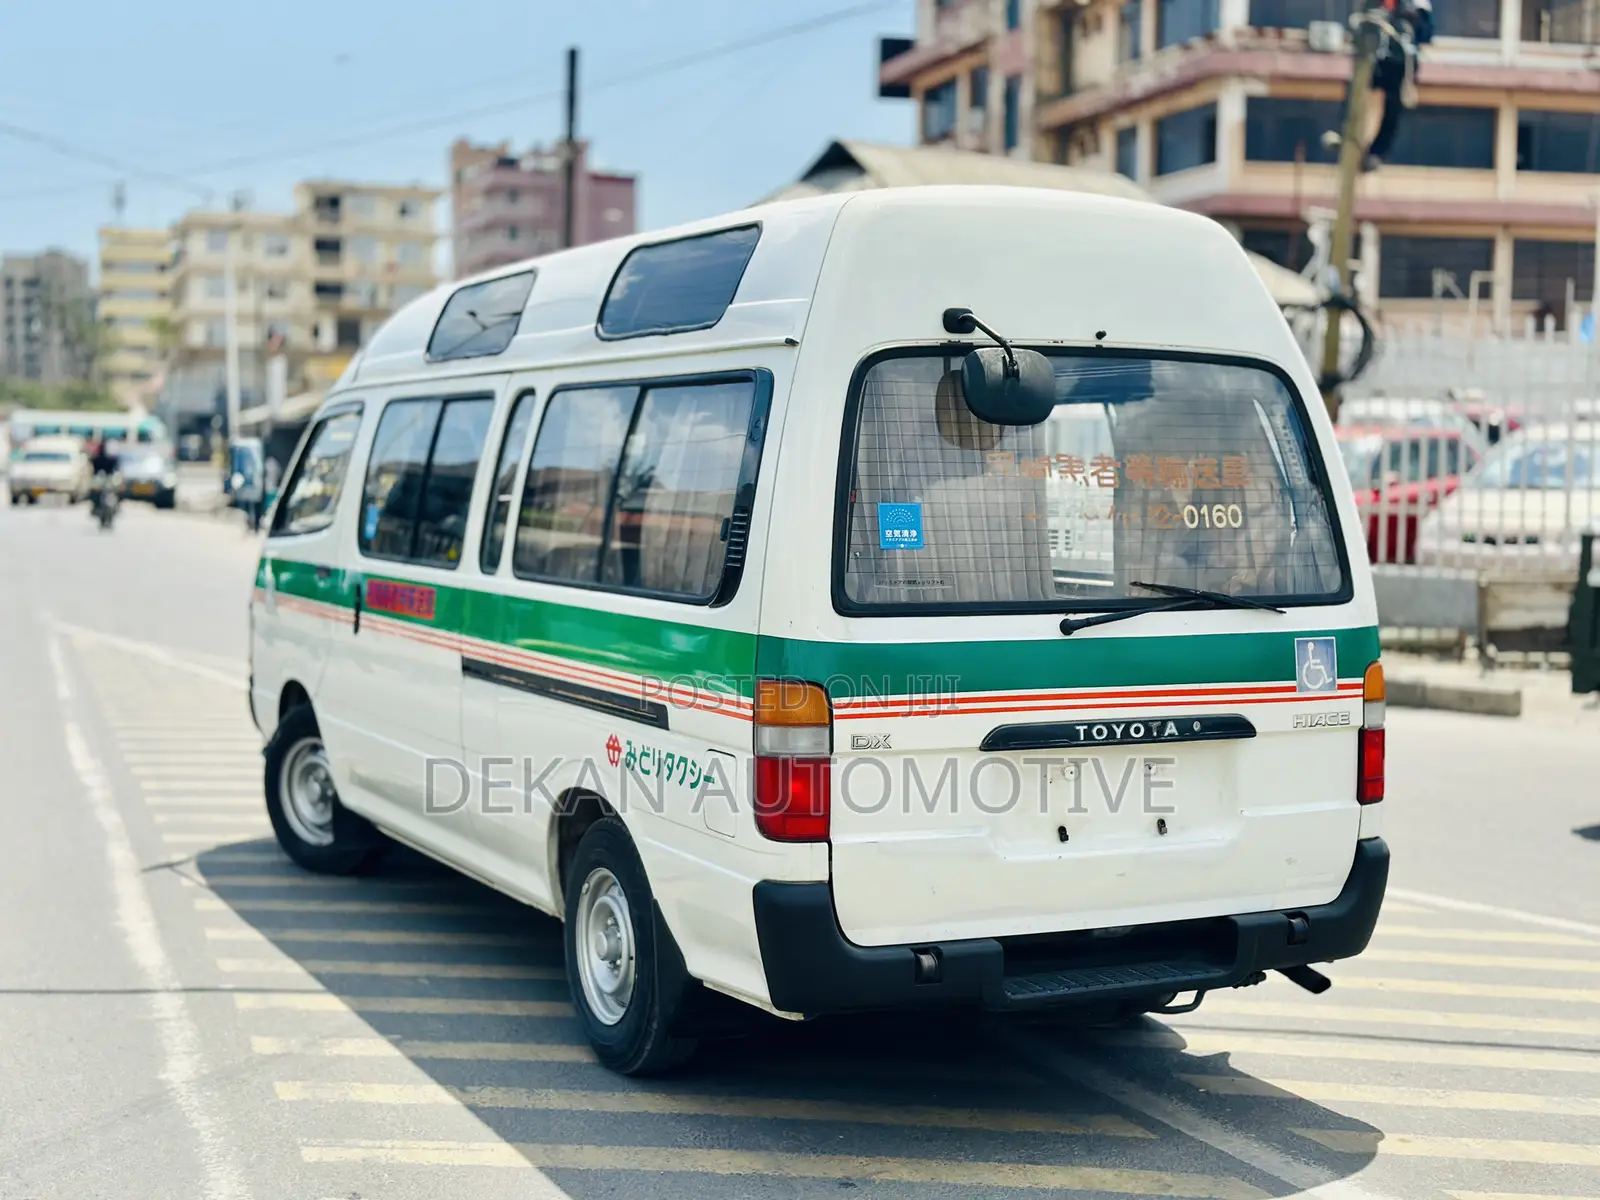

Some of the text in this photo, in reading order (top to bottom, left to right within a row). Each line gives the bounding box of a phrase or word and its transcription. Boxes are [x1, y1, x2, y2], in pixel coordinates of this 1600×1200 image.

[1292, 711, 1351, 728] HIACE
[1074, 720, 1180, 741] TOYOTA
[850, 733, 893, 750] DX
[624, 739, 716, 790] みどりタクシー
